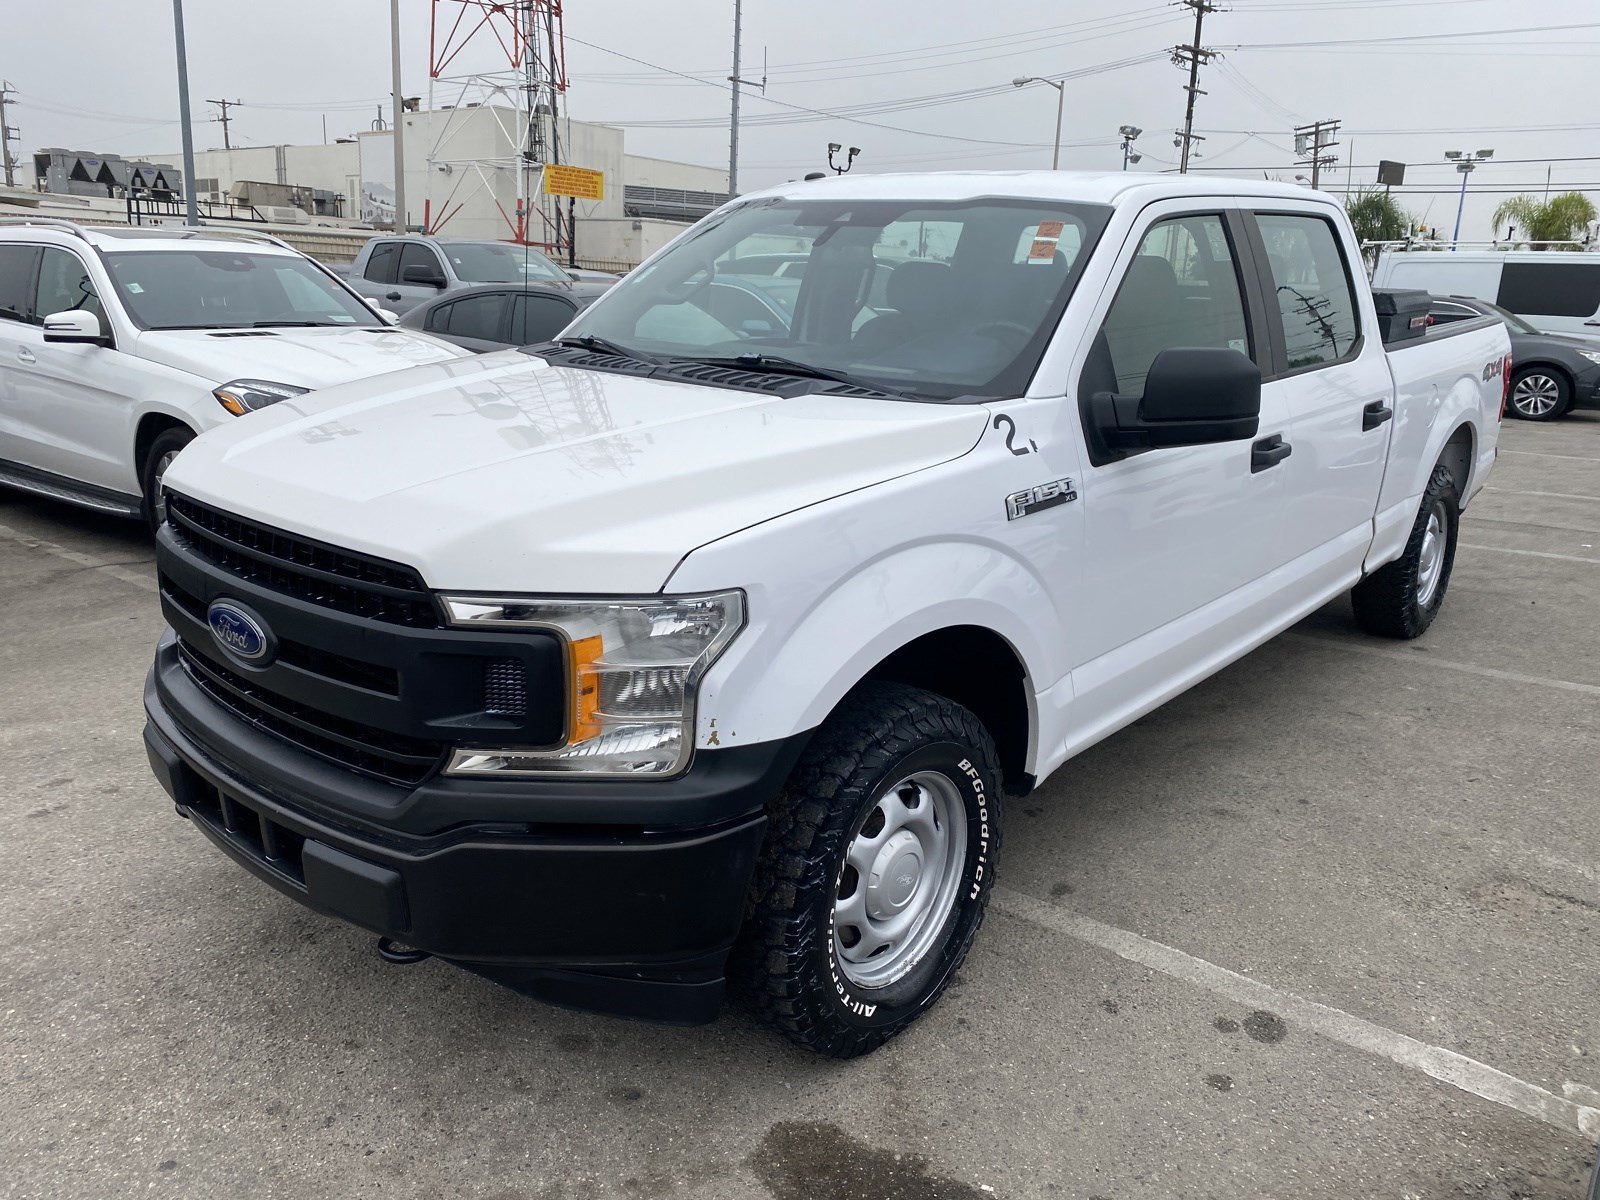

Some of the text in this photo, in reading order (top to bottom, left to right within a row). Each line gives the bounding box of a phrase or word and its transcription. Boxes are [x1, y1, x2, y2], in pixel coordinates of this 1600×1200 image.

[1065, 494, 1075, 502] XL
[217, 614, 249, 649] Ford
[957, 758, 989, 900] BFGoodrich
[827, 907, 877, 1018] All-Terrain
